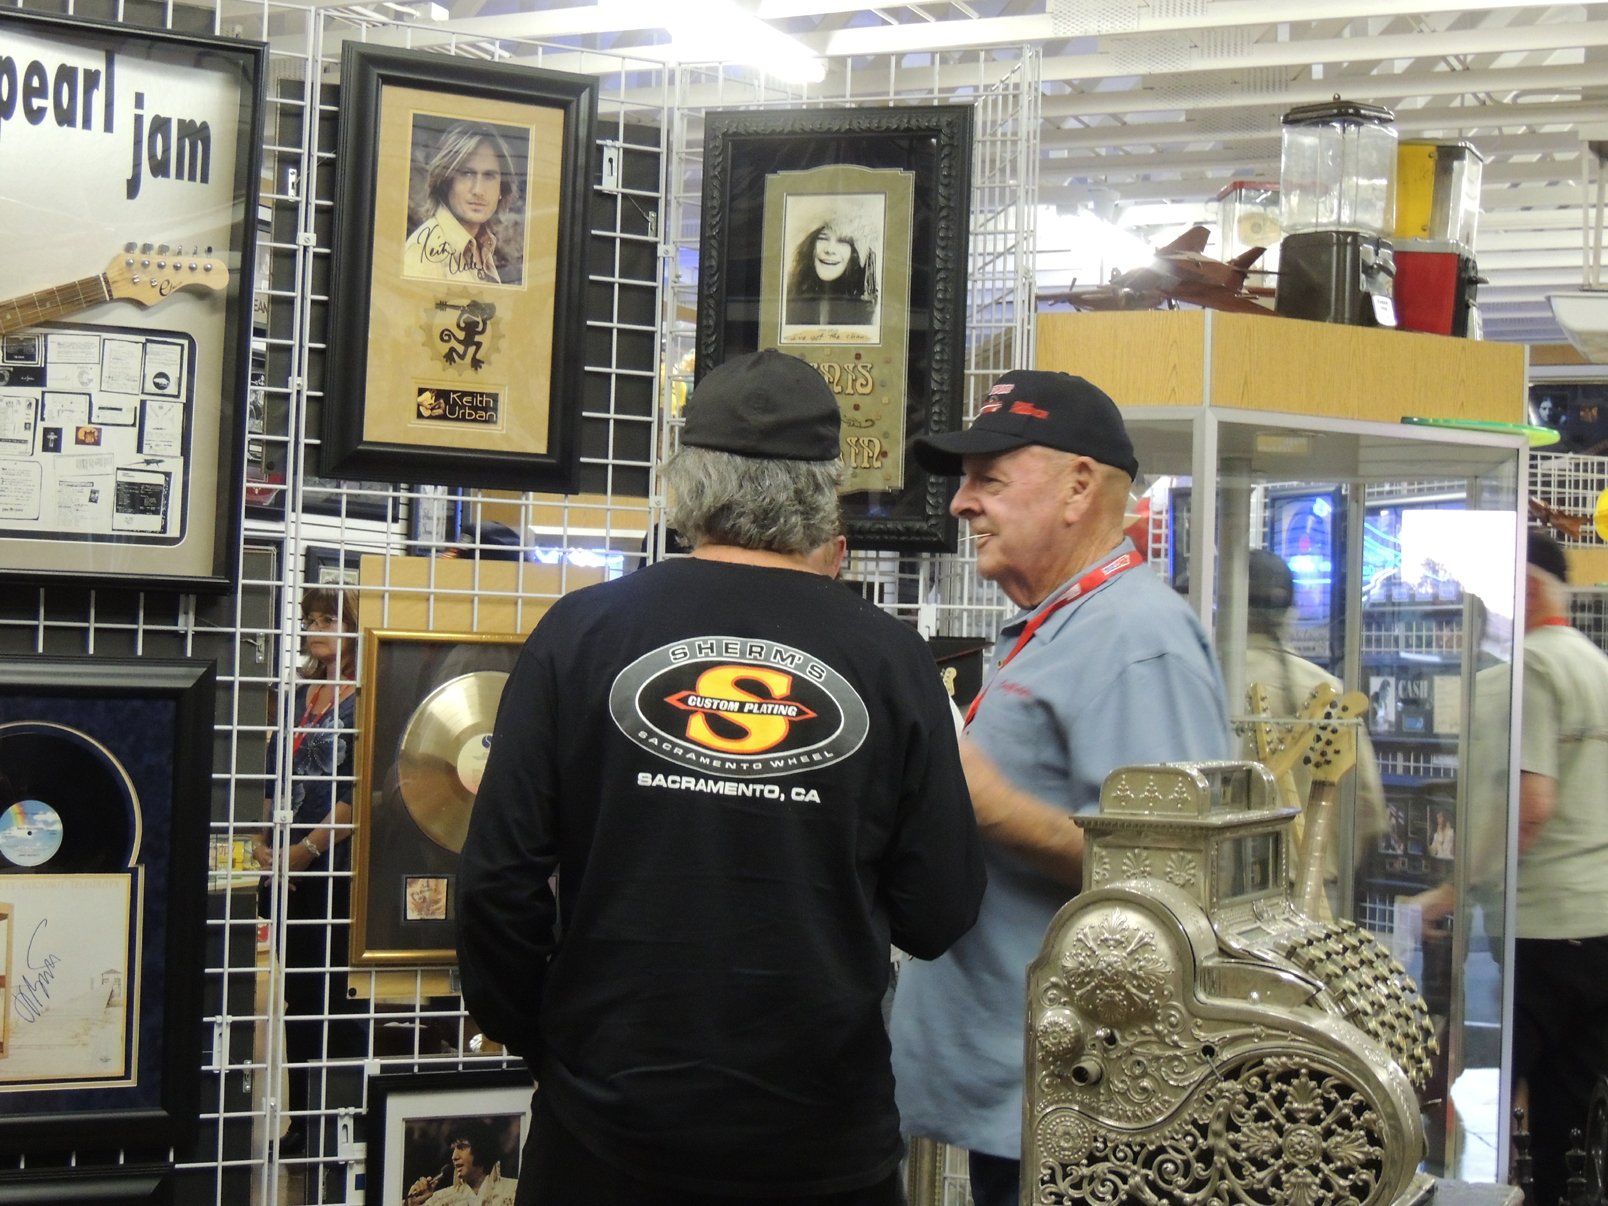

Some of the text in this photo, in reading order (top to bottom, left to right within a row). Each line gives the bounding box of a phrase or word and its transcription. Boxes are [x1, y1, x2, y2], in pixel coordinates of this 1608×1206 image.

[0, 50, 116, 142] pearl
[126, 92, 211, 200] jam
[810, 363, 874, 395] NIS
[446, 405, 497, 421] Urban
[449, 392, 493, 407] Keith
[669, 639, 827, 682] SHERM'S
[1398, 680, 1428, 699] CASH
[687, 695, 798, 717] CUSTOM PLATING
[638, 730, 835, 770] SACRAMENTO WHEEL
[637, 772, 821, 803] SACRAMENTO, CA
